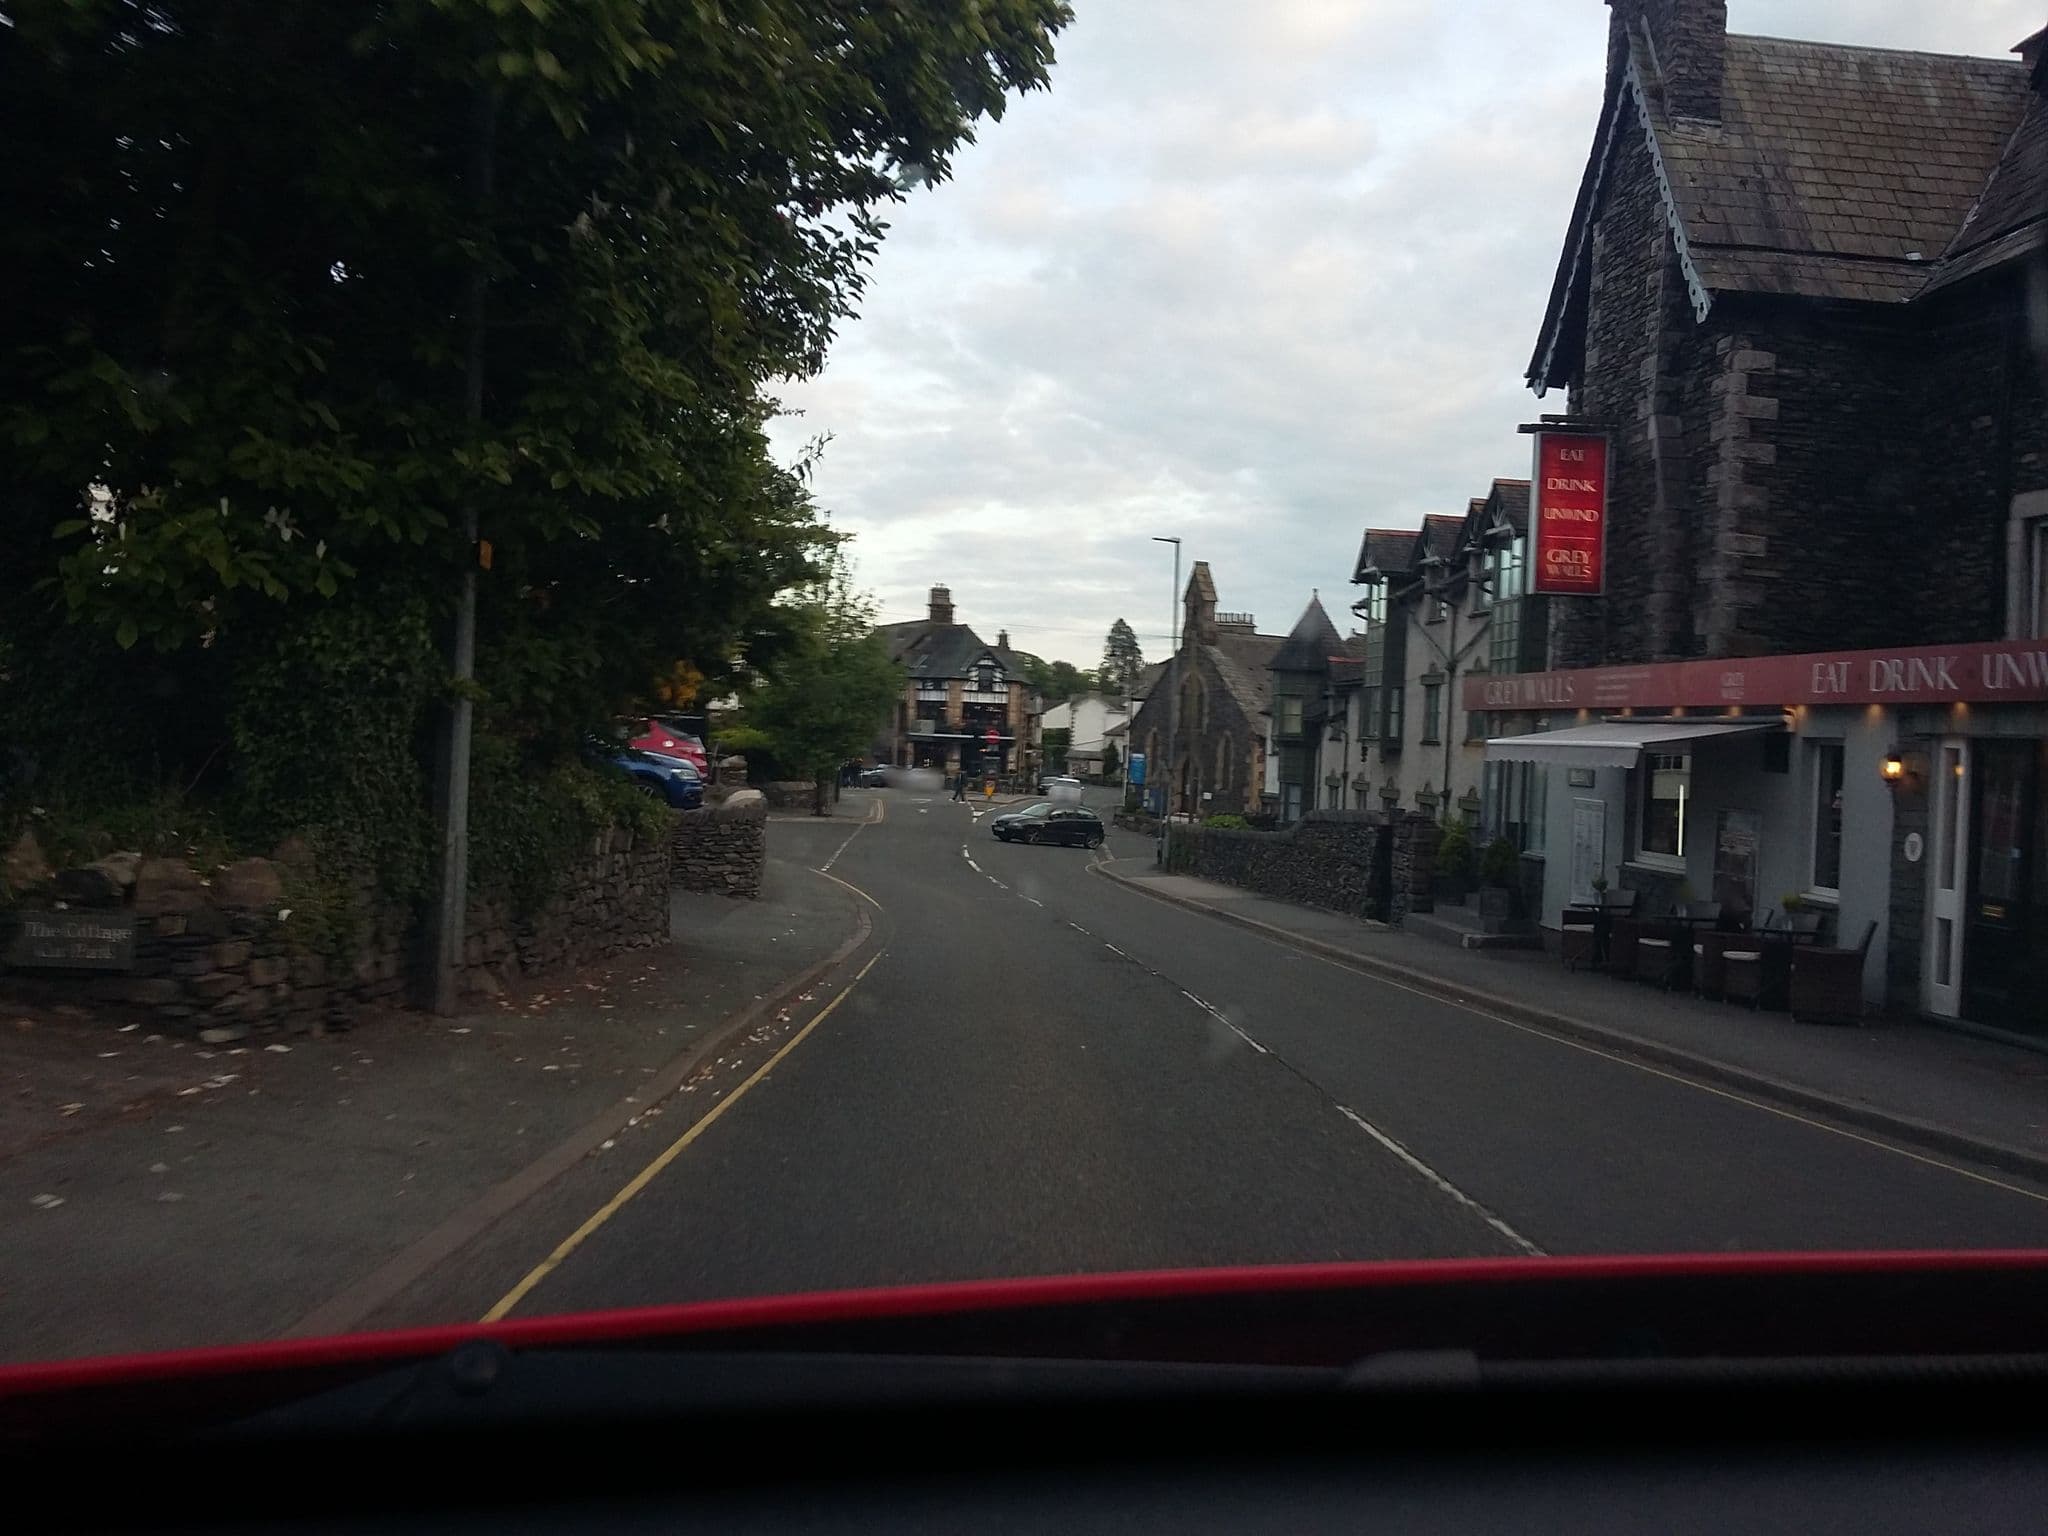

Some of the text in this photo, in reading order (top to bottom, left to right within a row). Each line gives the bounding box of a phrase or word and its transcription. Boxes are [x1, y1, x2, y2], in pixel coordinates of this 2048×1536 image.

[1560, 448, 1585, 462] EAT
[1547, 477, 1597, 492] DRINK
[1544, 507, 1599, 522] UNWIND
[1546, 549, 1592, 564] GREY
[1546, 564, 1592, 577] WALLS
[1812, 661, 1853, 694] EAT
[1869, 656, 1959, 693] DRINK
[1486, 677, 1575, 705] GREY WALLS
[24, 920, 66, 938] The
